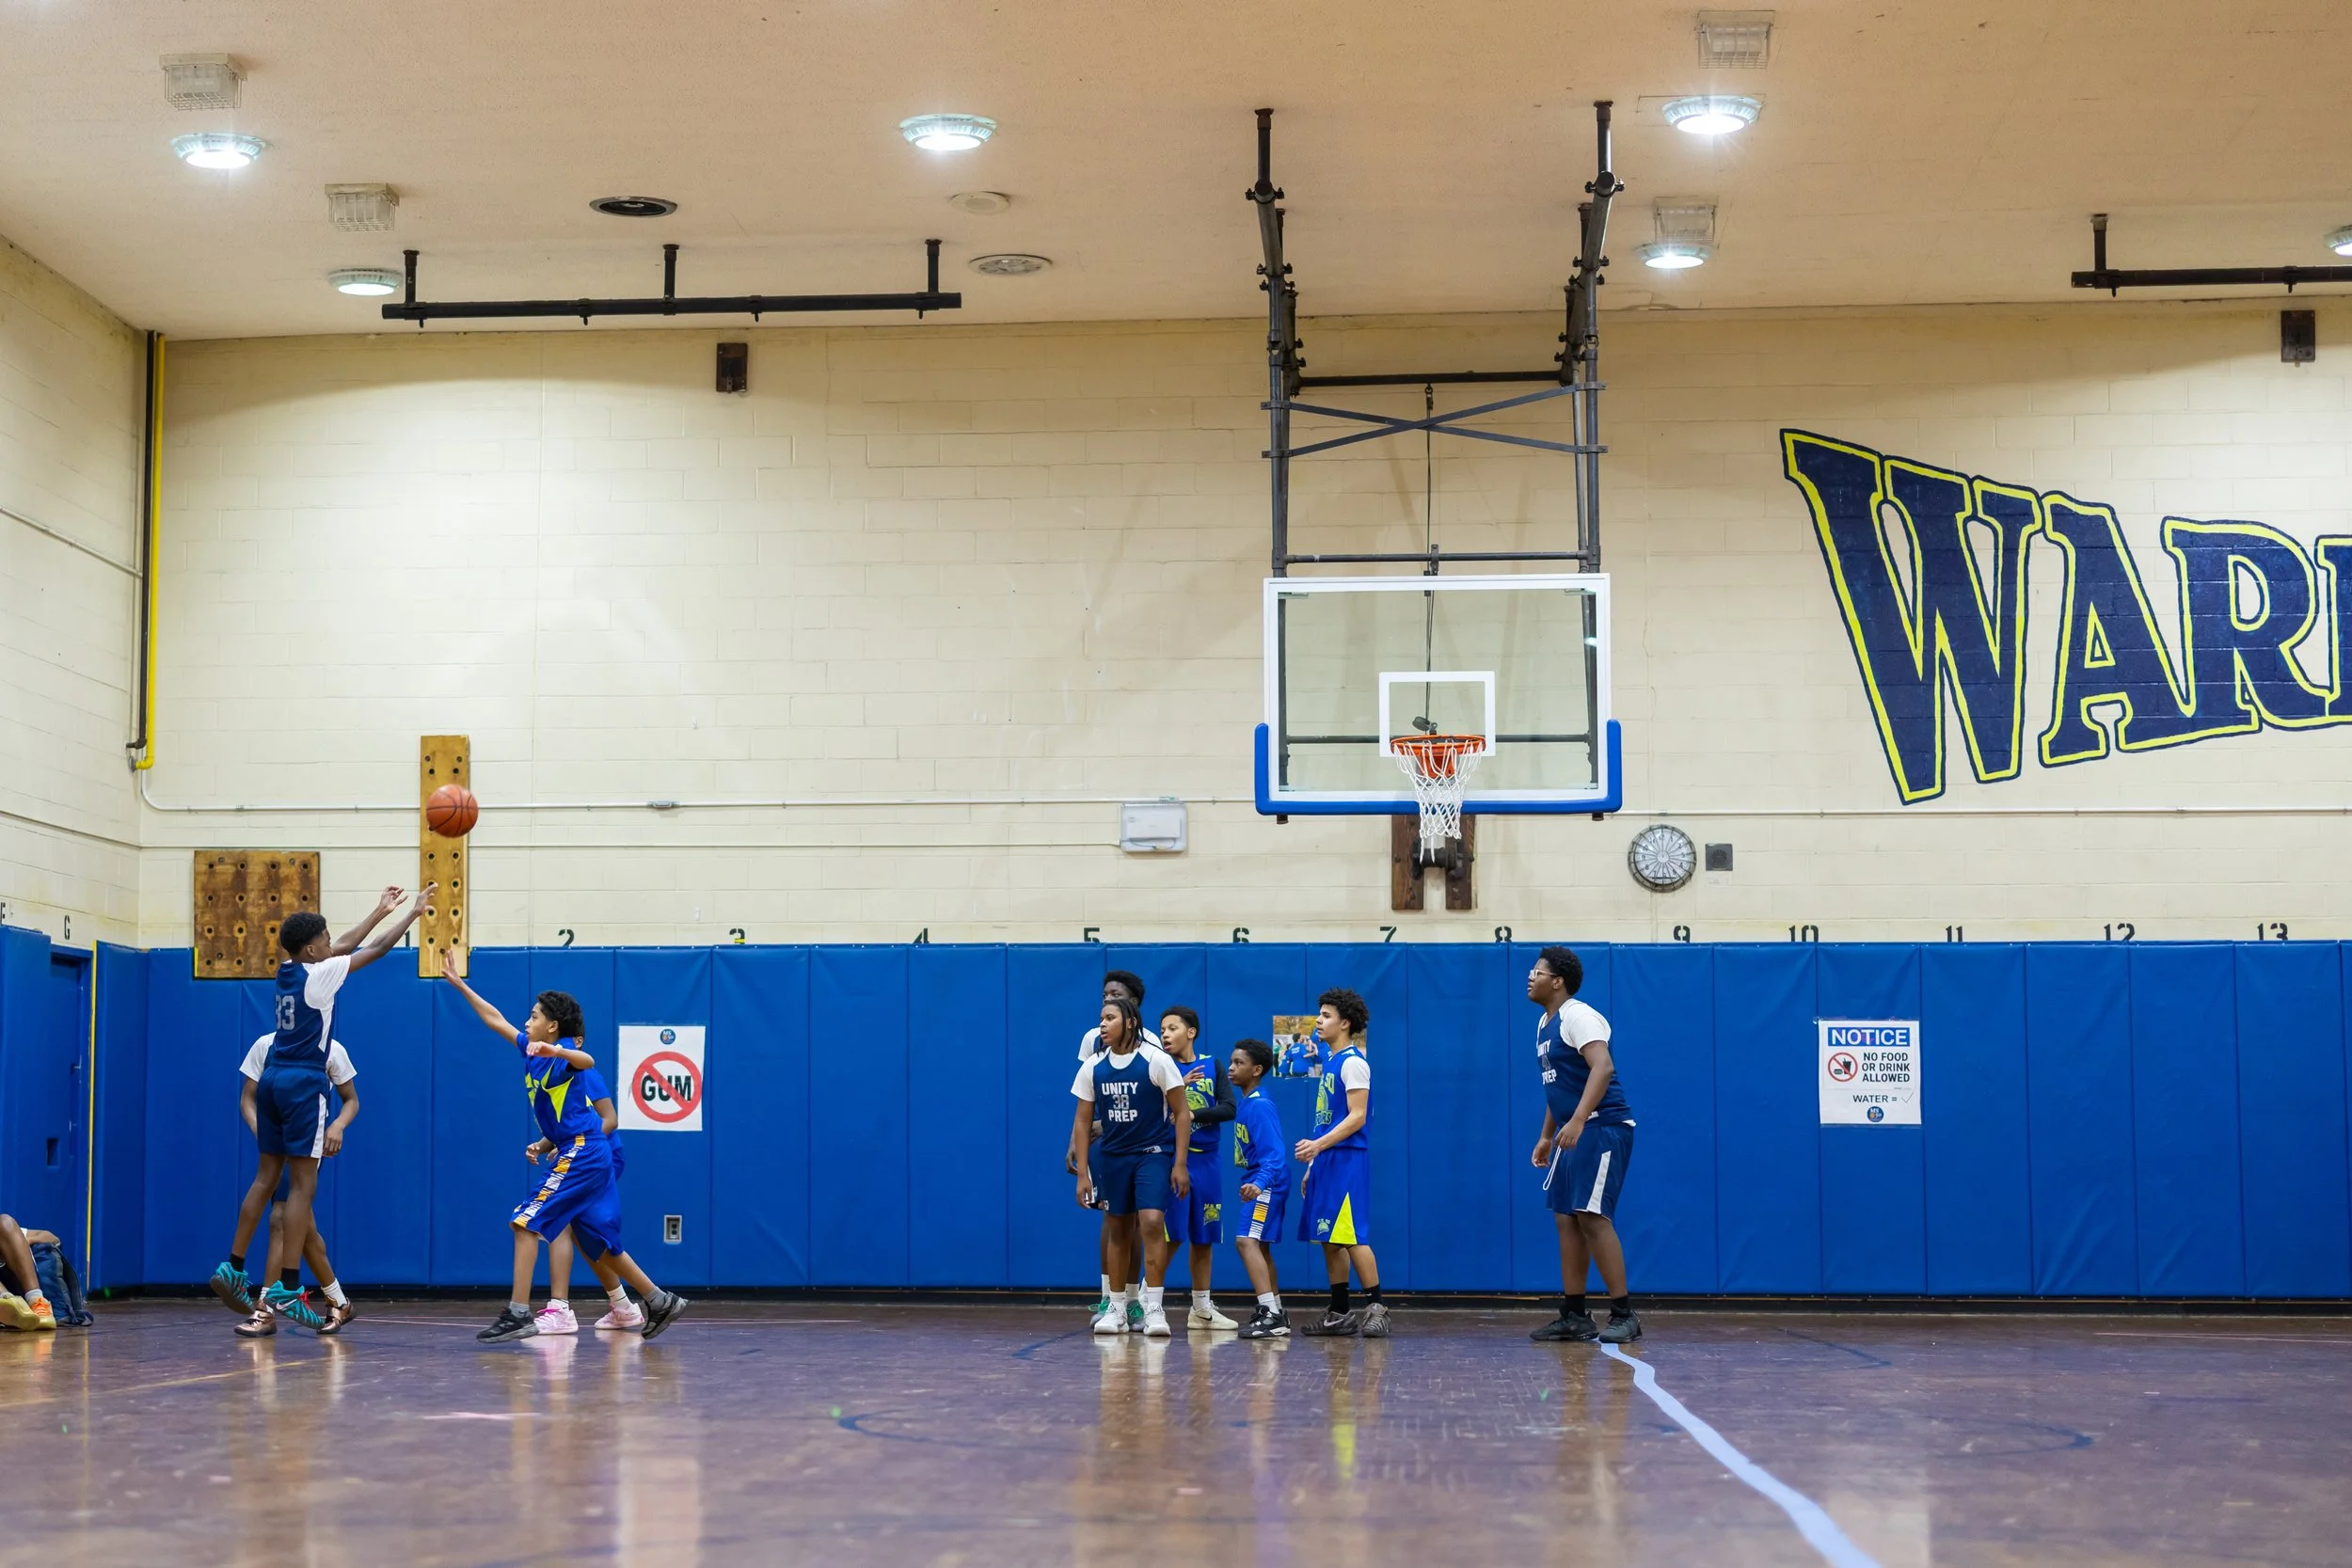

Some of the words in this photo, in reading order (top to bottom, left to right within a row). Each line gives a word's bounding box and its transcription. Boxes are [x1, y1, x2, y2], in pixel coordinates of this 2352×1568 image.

[1780, 429, 2352, 805] WAR
[64, 915, 71, 940] G
[729, 928, 745, 944] 3
[913, 927, 930, 944] 4
[1083, 927, 1100, 943] 5
[1379, 927, 1397, 943] 7
[1673, 925, 1691, 943] 9
[1788, 925, 1819, 942] 10
[1946, 925, 1963, 942] 11
[2104, 923, 2135, 942] 12
[2257, 923, 2288, 941] 13
[558, 928, 575, 946] 2
[1831, 1029, 1908, 1046] NOTICE
[1863, 1053, 1878, 1061] NO
[1881, 1053, 1908, 1061] FOOD
[1862, 1063, 1876, 1071] OR
[1879, 1063, 1910, 1071] DRINK
[1862, 1073, 1910, 1082] ALLOWED
[641, 1074, 691, 1102] GUM
[1102, 1082, 1138, 1096] UNITY
[1113, 1095, 1129, 1110] 38
[1852, 1095, 1888, 1103] WATER
[1108, 1110, 1138, 1122] PREP
